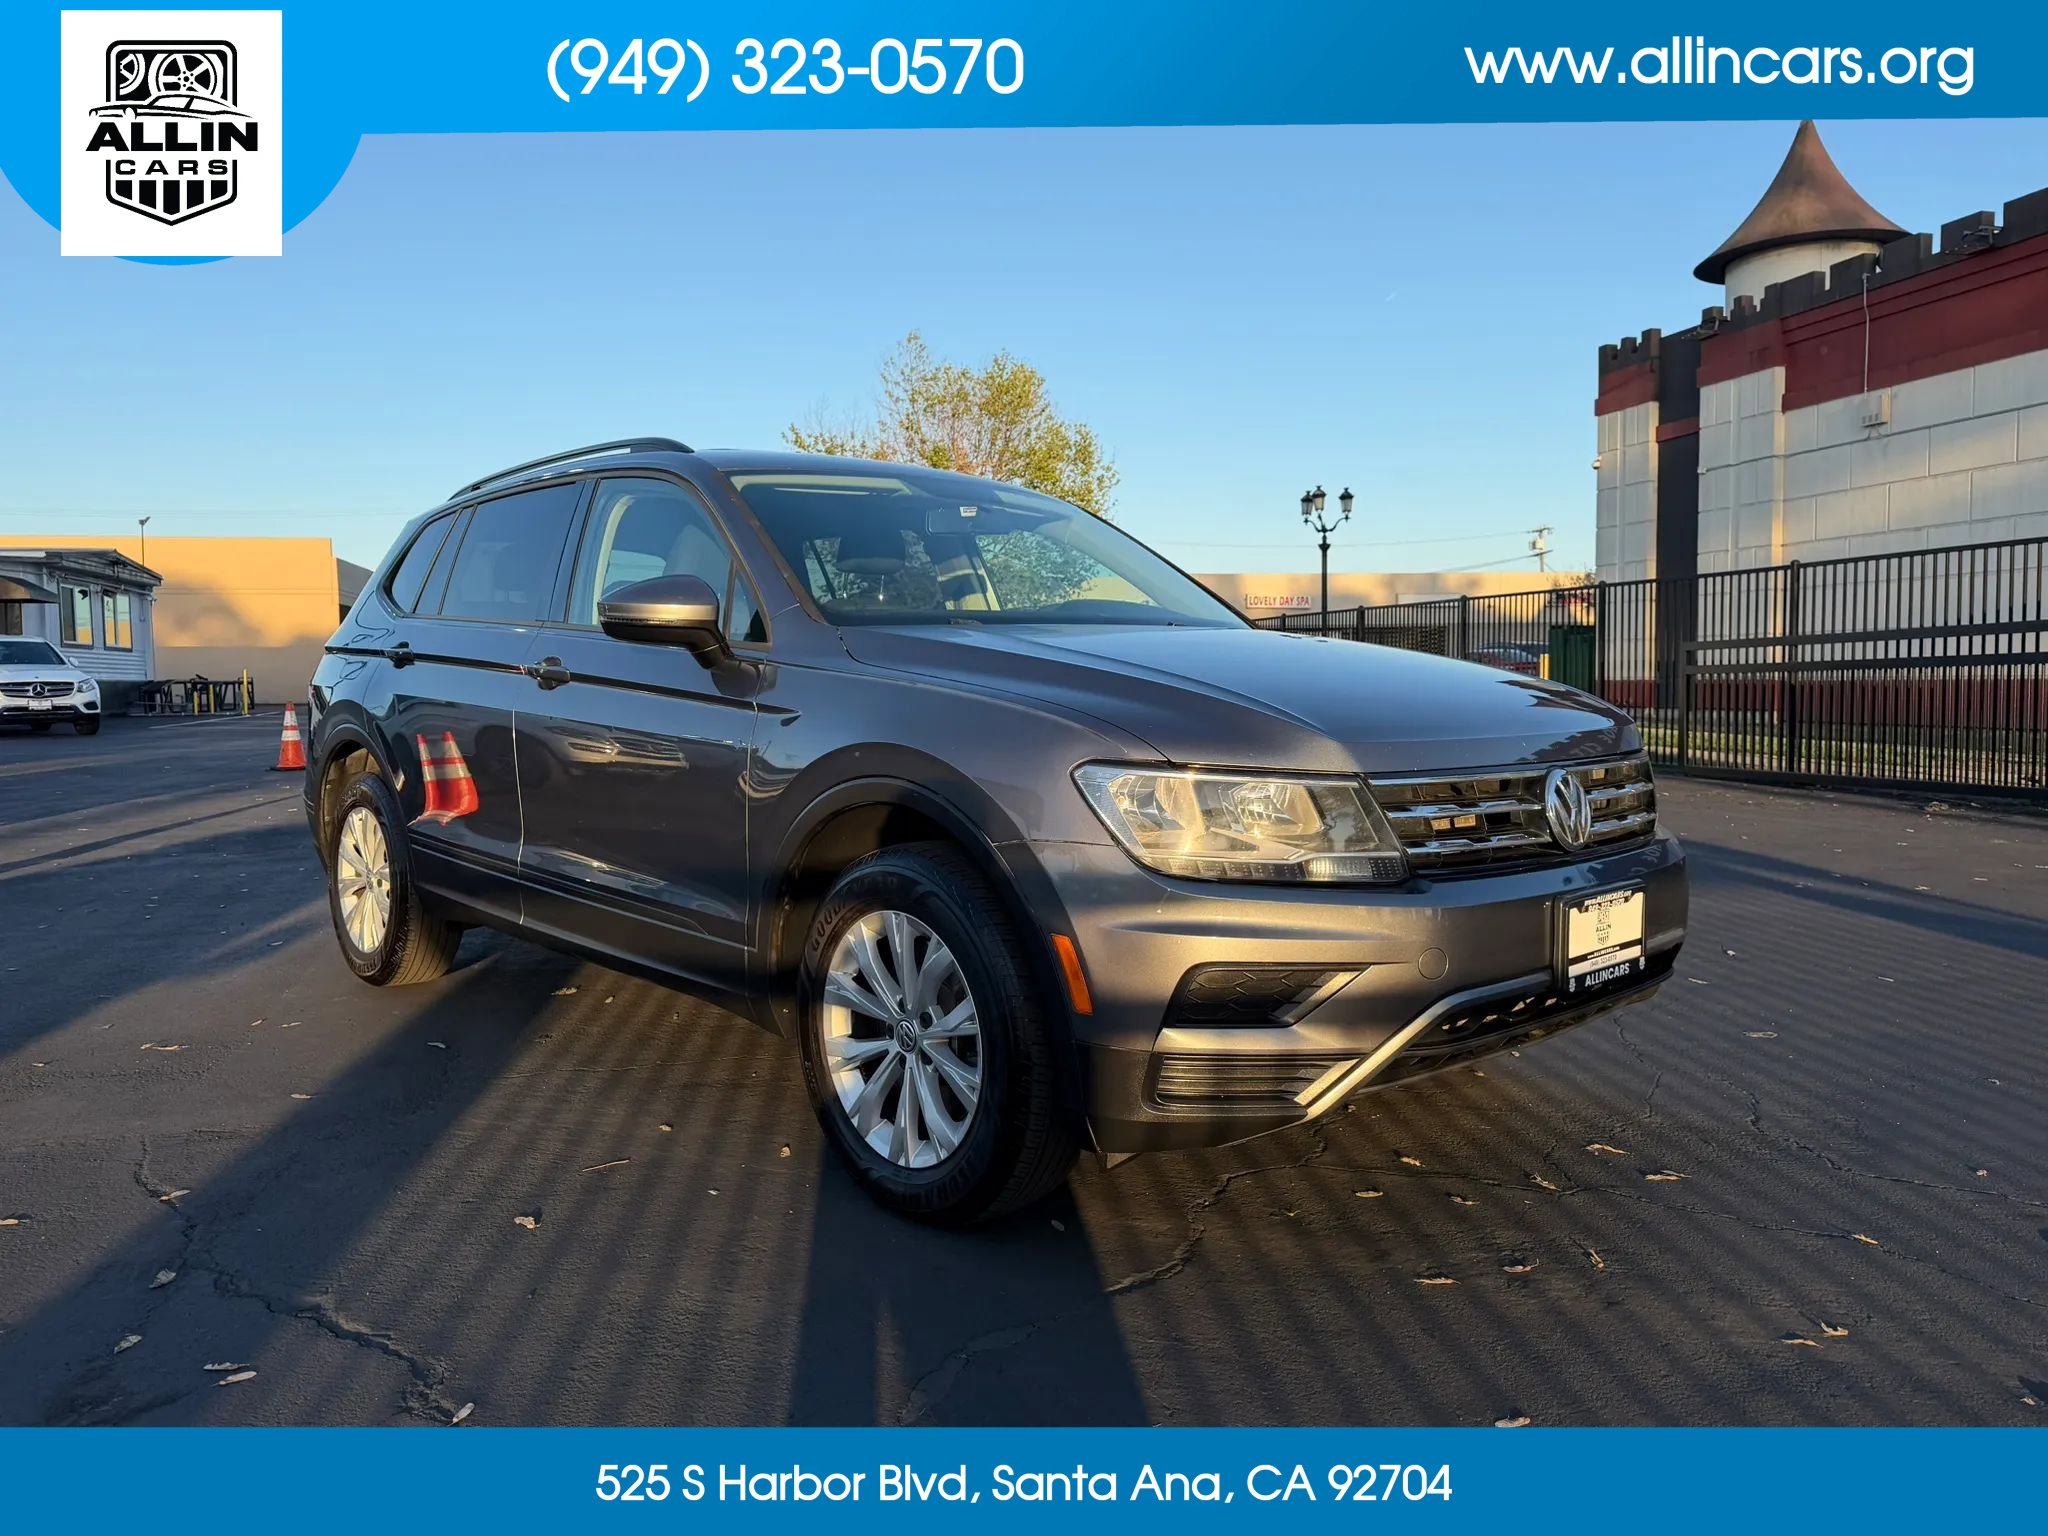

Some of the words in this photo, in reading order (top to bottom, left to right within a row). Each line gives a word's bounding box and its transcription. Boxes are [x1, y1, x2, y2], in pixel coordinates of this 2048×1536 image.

[1249, 596, 1277, 606] LOVELY
[1280, 596, 1294, 606] DAY
[1296, 596, 1310, 606] SPA
[1585, 963, 1630, 987] ALLINCARS
